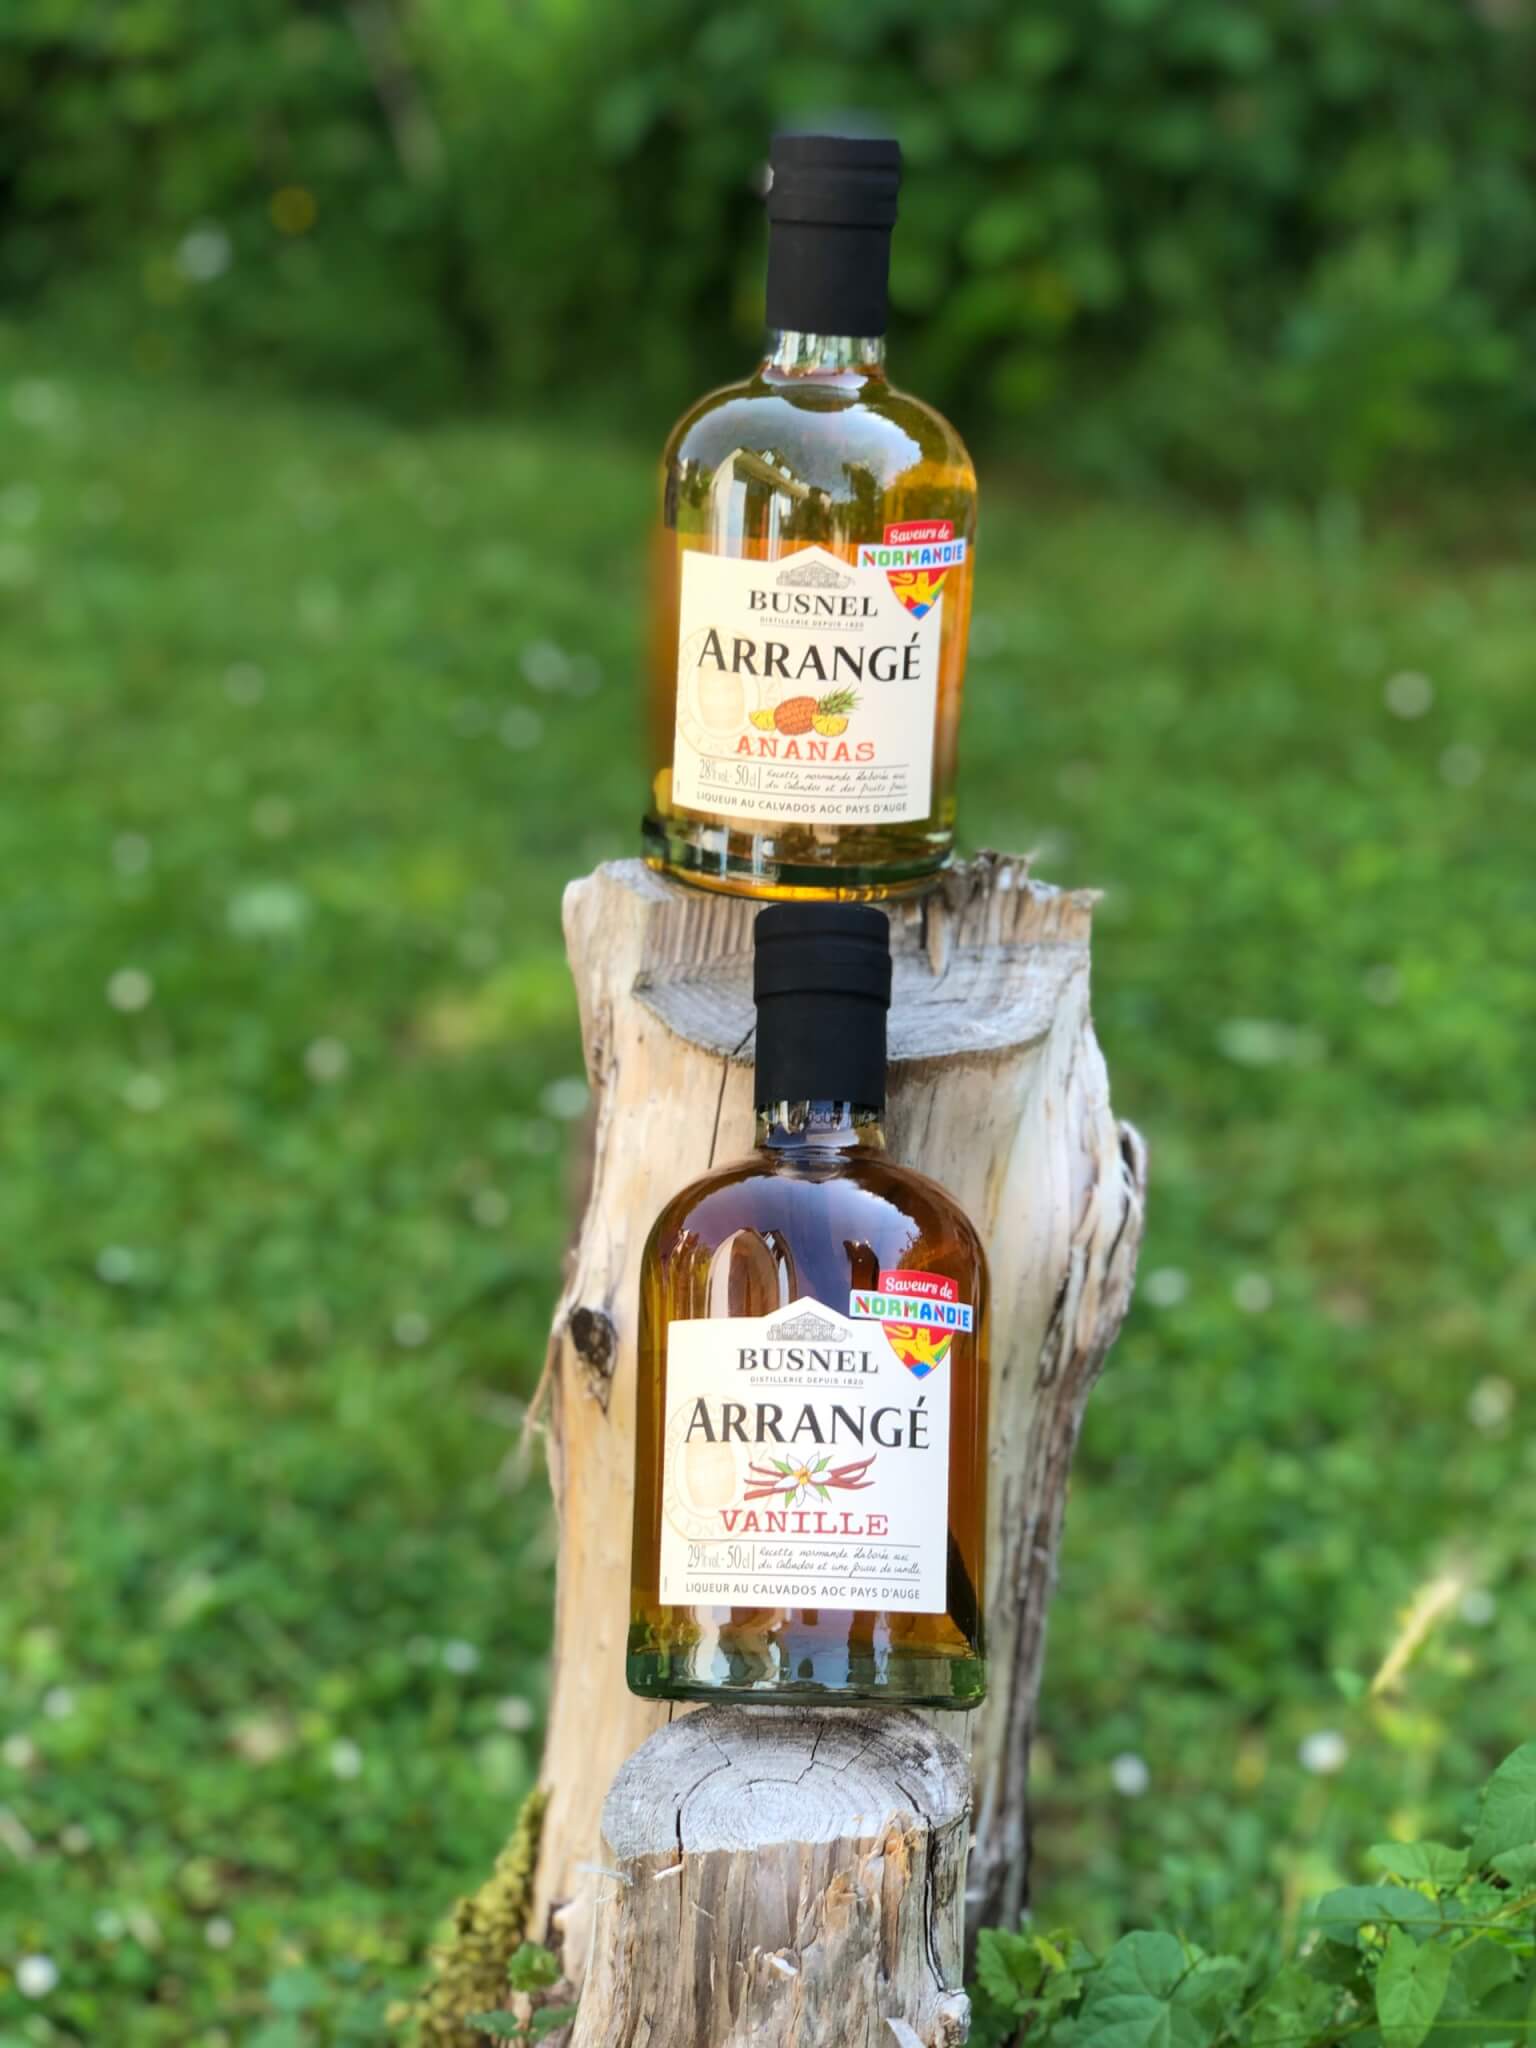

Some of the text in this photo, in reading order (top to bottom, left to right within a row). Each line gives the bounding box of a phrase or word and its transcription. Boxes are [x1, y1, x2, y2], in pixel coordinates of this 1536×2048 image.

[889, 523, 950, 545] Saveurs de
[862, 543, 963, 567] NORMANDIE
[748, 590, 878, 617] BUSNEL
[697, 628, 921, 682] ARRANGÉ
[736, 735, 876, 763] ANANAS
[697, 791, 908, 814] LIQUEUR AU CALVADOS AOC PAYS D'AUGE
[885, 1276, 953, 1299] Saveurs de
[854, 1295, 970, 1328] NORMANDIE
[737, 1348, 879, 1374] BUSNEL
[750, 1376, 803, 1384] DISTILLERIE
[807, 1376, 839, 1385] DEPUIS
[684, 1396, 930, 1450] ARRANGÉ
[719, 1509, 889, 1536] VANILLE
[685, 1582, 920, 1600] LIQUEUR AU CALVADOS AOC PAYS D'AUGE
